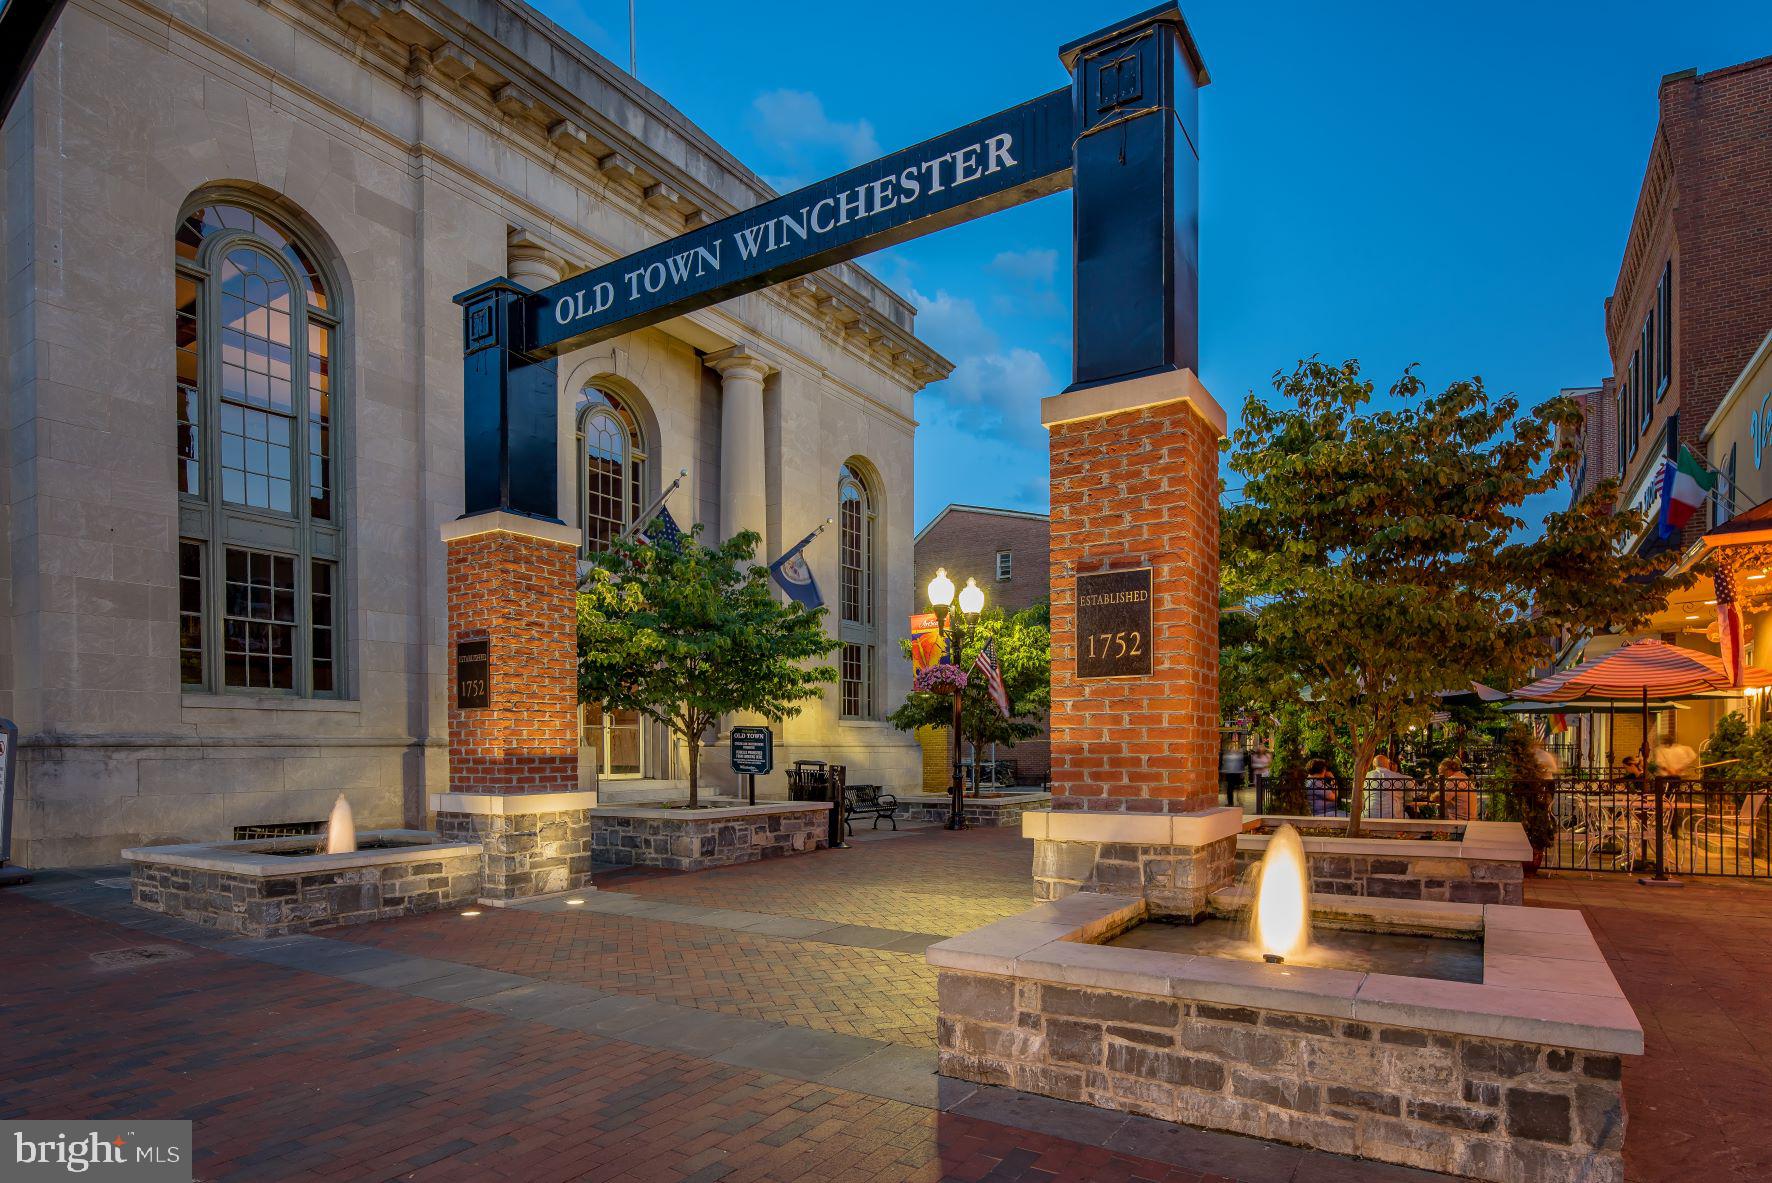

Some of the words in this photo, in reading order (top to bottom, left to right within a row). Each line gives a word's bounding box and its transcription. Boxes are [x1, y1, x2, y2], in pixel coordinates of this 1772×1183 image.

[555, 281, 614, 326] OLD
[624, 239, 724, 301] TOWN
[733, 132, 1018, 261] WINCHESTER
[1080, 590, 1148, 607] ESTABLISHED
[1088, 631, 1142, 659] 1752
[461, 680, 485, 697] 1752
